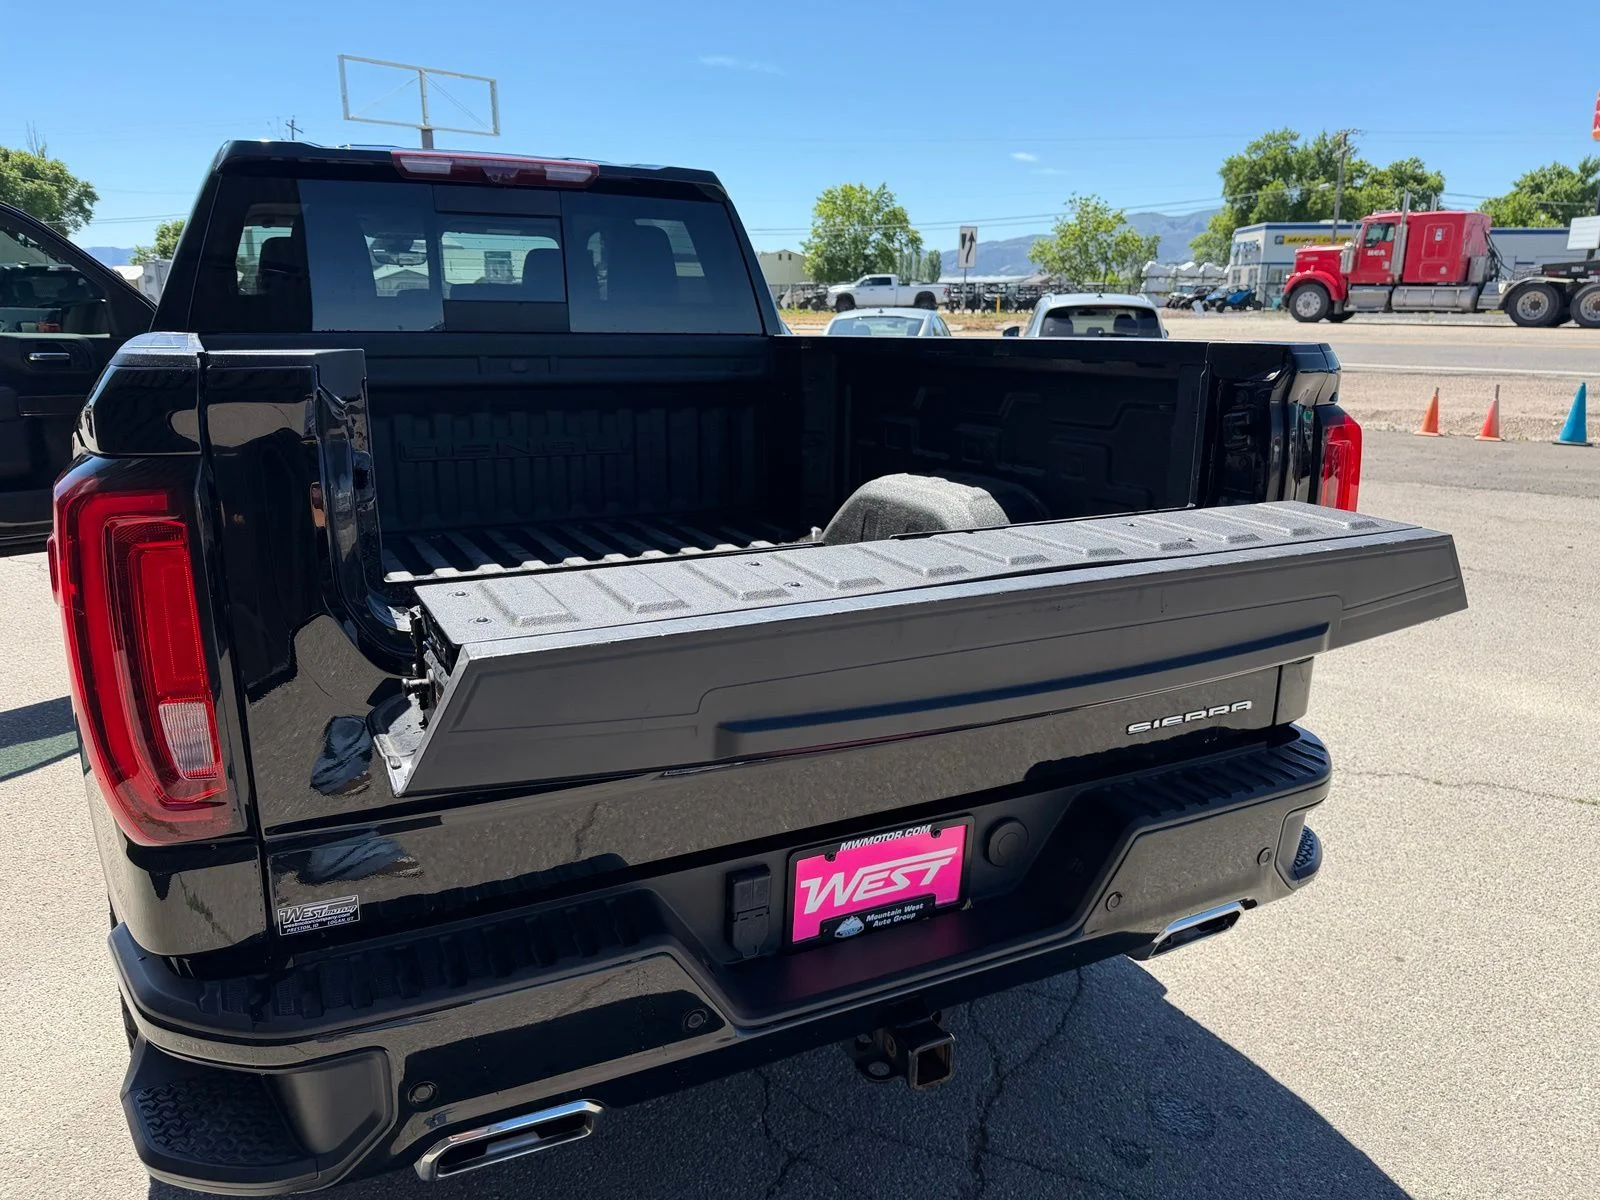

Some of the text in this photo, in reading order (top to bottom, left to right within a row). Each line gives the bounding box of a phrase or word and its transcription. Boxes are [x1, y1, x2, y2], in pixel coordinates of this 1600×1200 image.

[1127, 700, 1253, 735] SIERRA
[839, 824, 932, 852] MWMOTOR.COM
[800, 847, 958, 915] WEST
[865, 903, 924, 922] Mountain West
[872, 912, 916, 928] Auto Group
